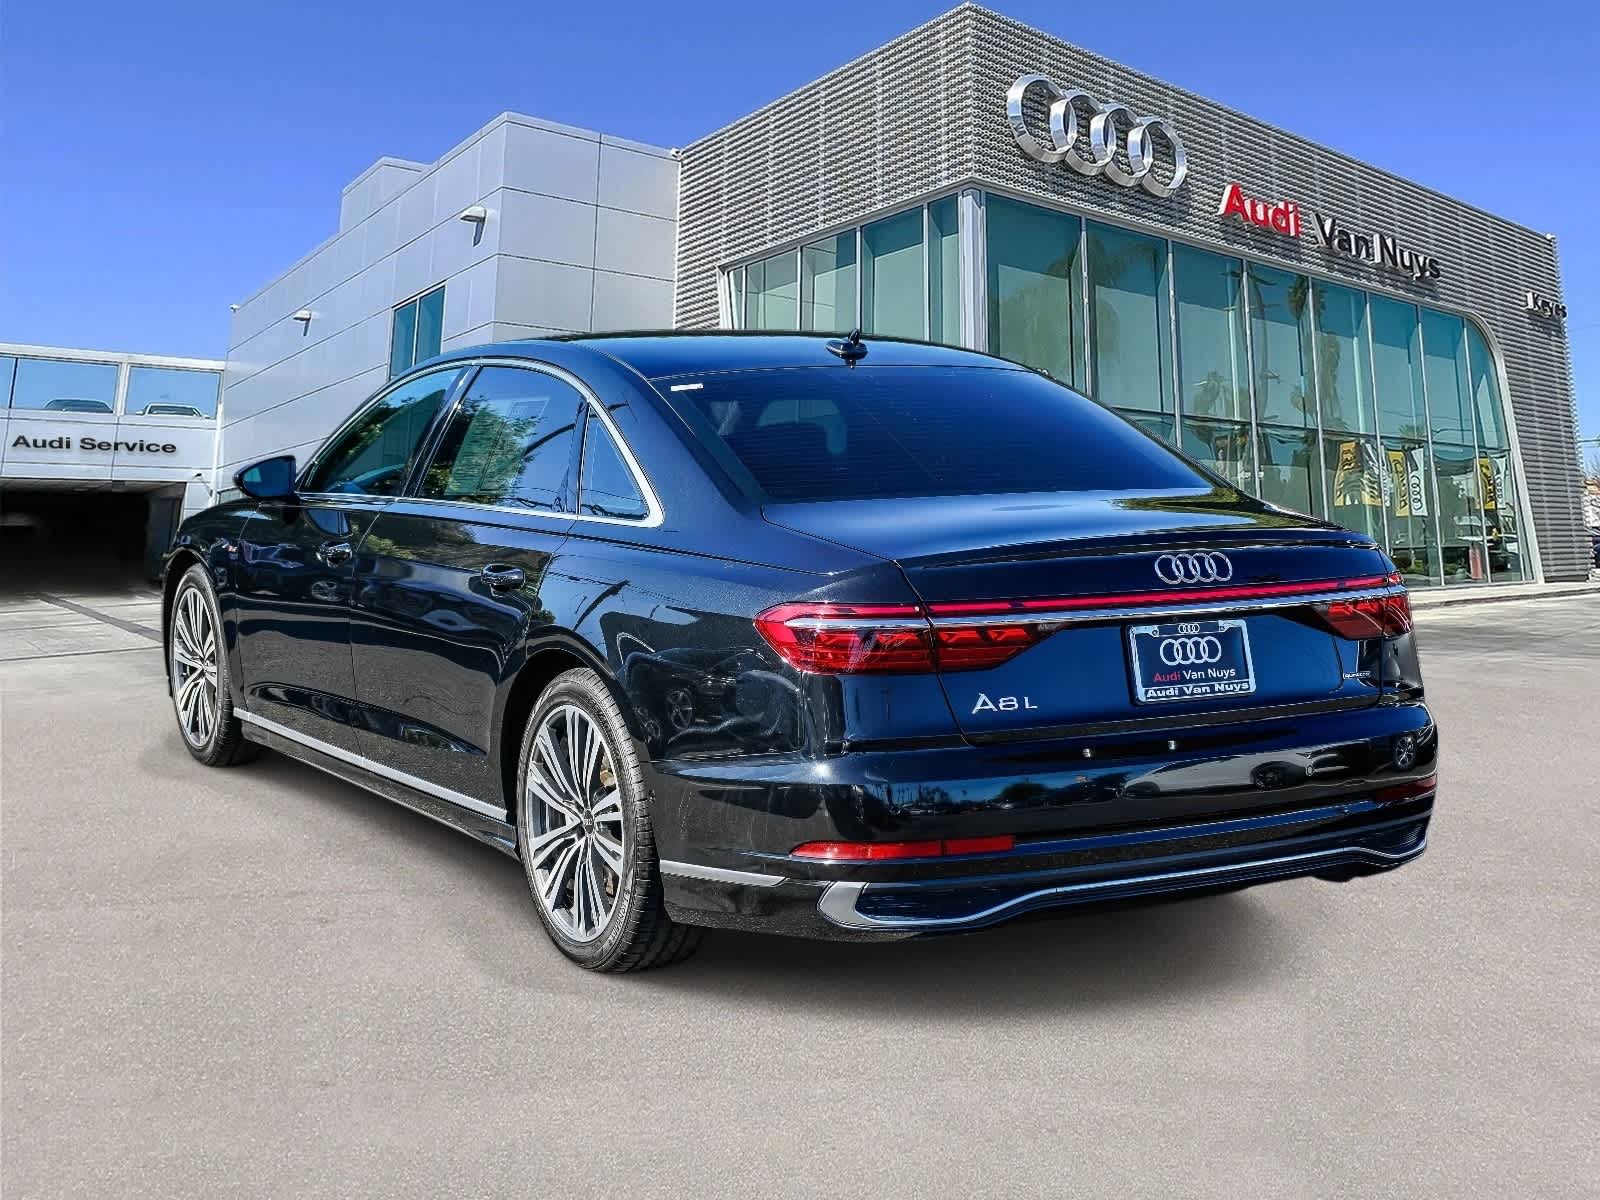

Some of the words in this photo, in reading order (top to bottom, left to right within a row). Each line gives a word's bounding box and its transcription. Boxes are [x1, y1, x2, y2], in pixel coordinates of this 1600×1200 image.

[1218, 182, 1302, 238] Audi
[1312, 211, 1371, 259] Van
[1374, 232, 1442, 280] Nuys
[12, 435, 71, 449] Audi
[80, 437, 177, 454] Service
[1154, 671, 1180, 682] Audi
[1183, 669, 1205, 680] Van
[1207, 668, 1236, 679] Nuys
[1146, 687, 1179, 698] Audi
[1183, 685, 1211, 695] Van
[1214, 681, 1249, 692] Nuys
